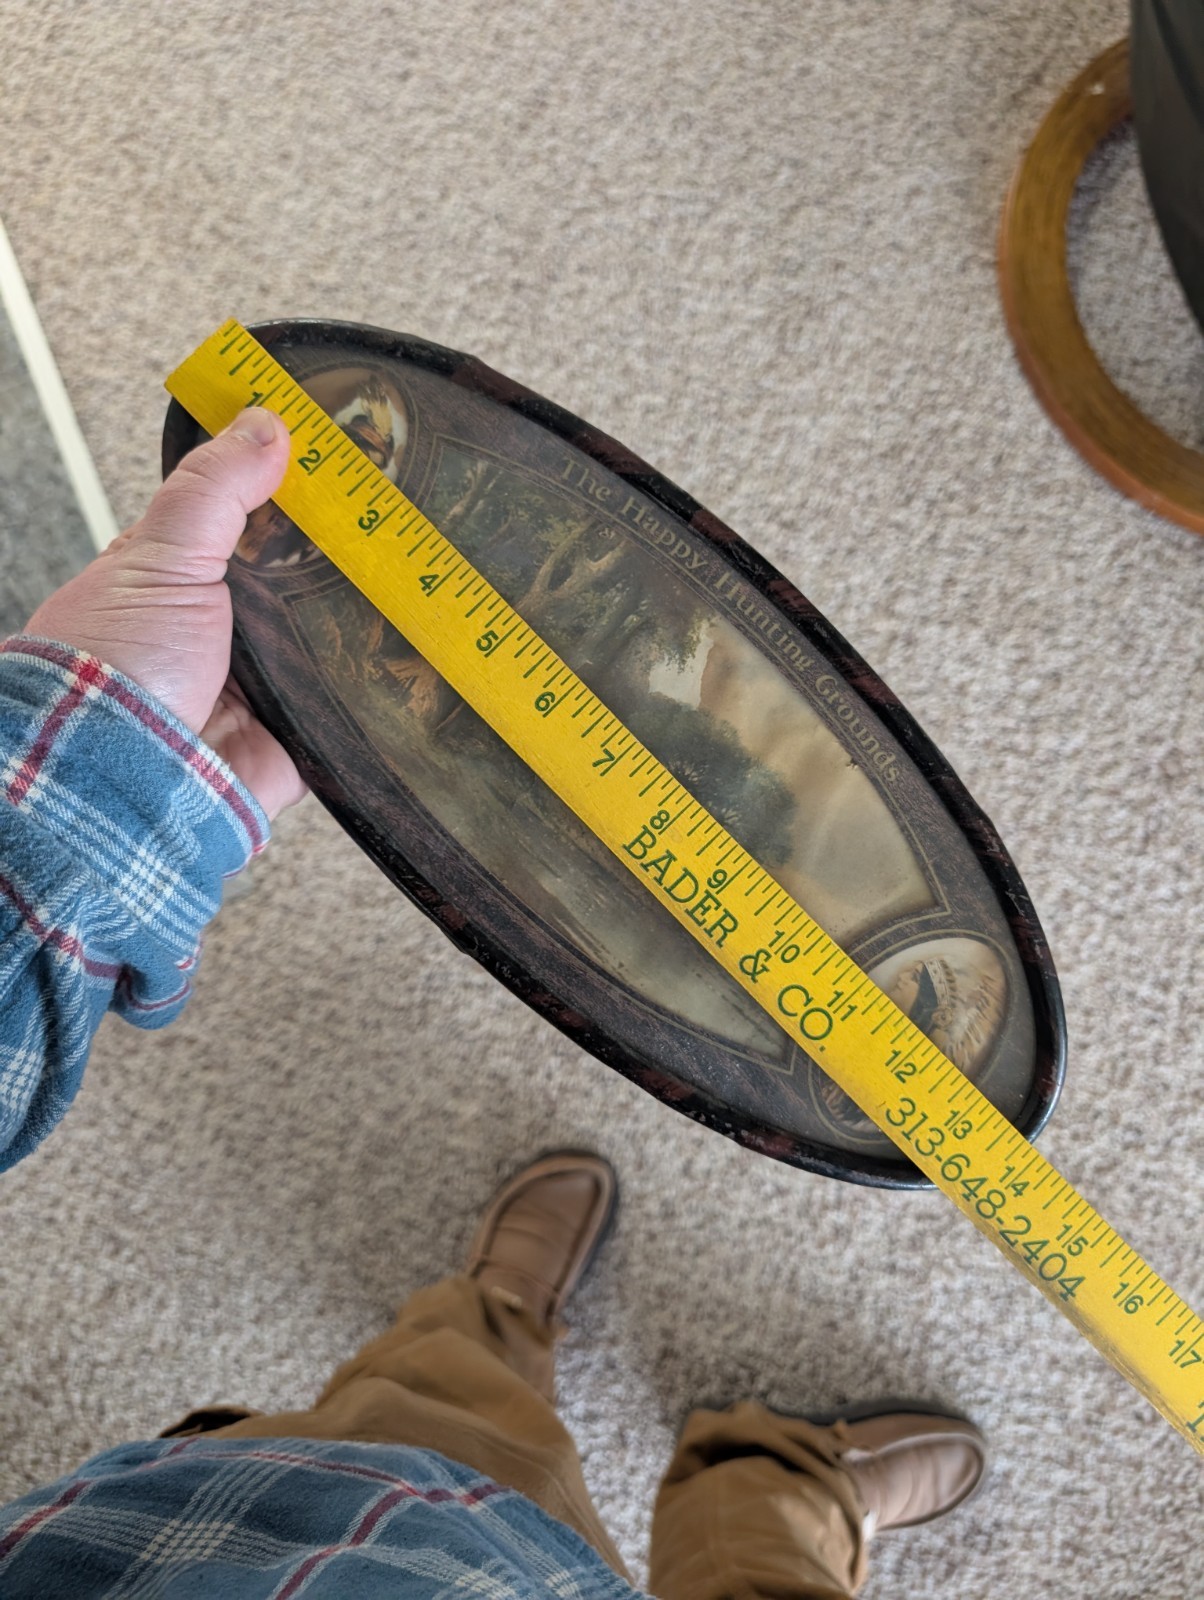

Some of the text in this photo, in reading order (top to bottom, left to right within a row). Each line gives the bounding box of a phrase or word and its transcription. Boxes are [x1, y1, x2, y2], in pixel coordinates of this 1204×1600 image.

[560, 456, 899, 783] The Happy Hunting Grounds
[244, 391, 1201, 1368] 1 2 3 4 5 6 7 8 9 10 11 12 13 14 15 16 17
[622, 824, 834, 1052] BADER & CO.
[885, 1097, 1086, 1302] 313-648-2404
